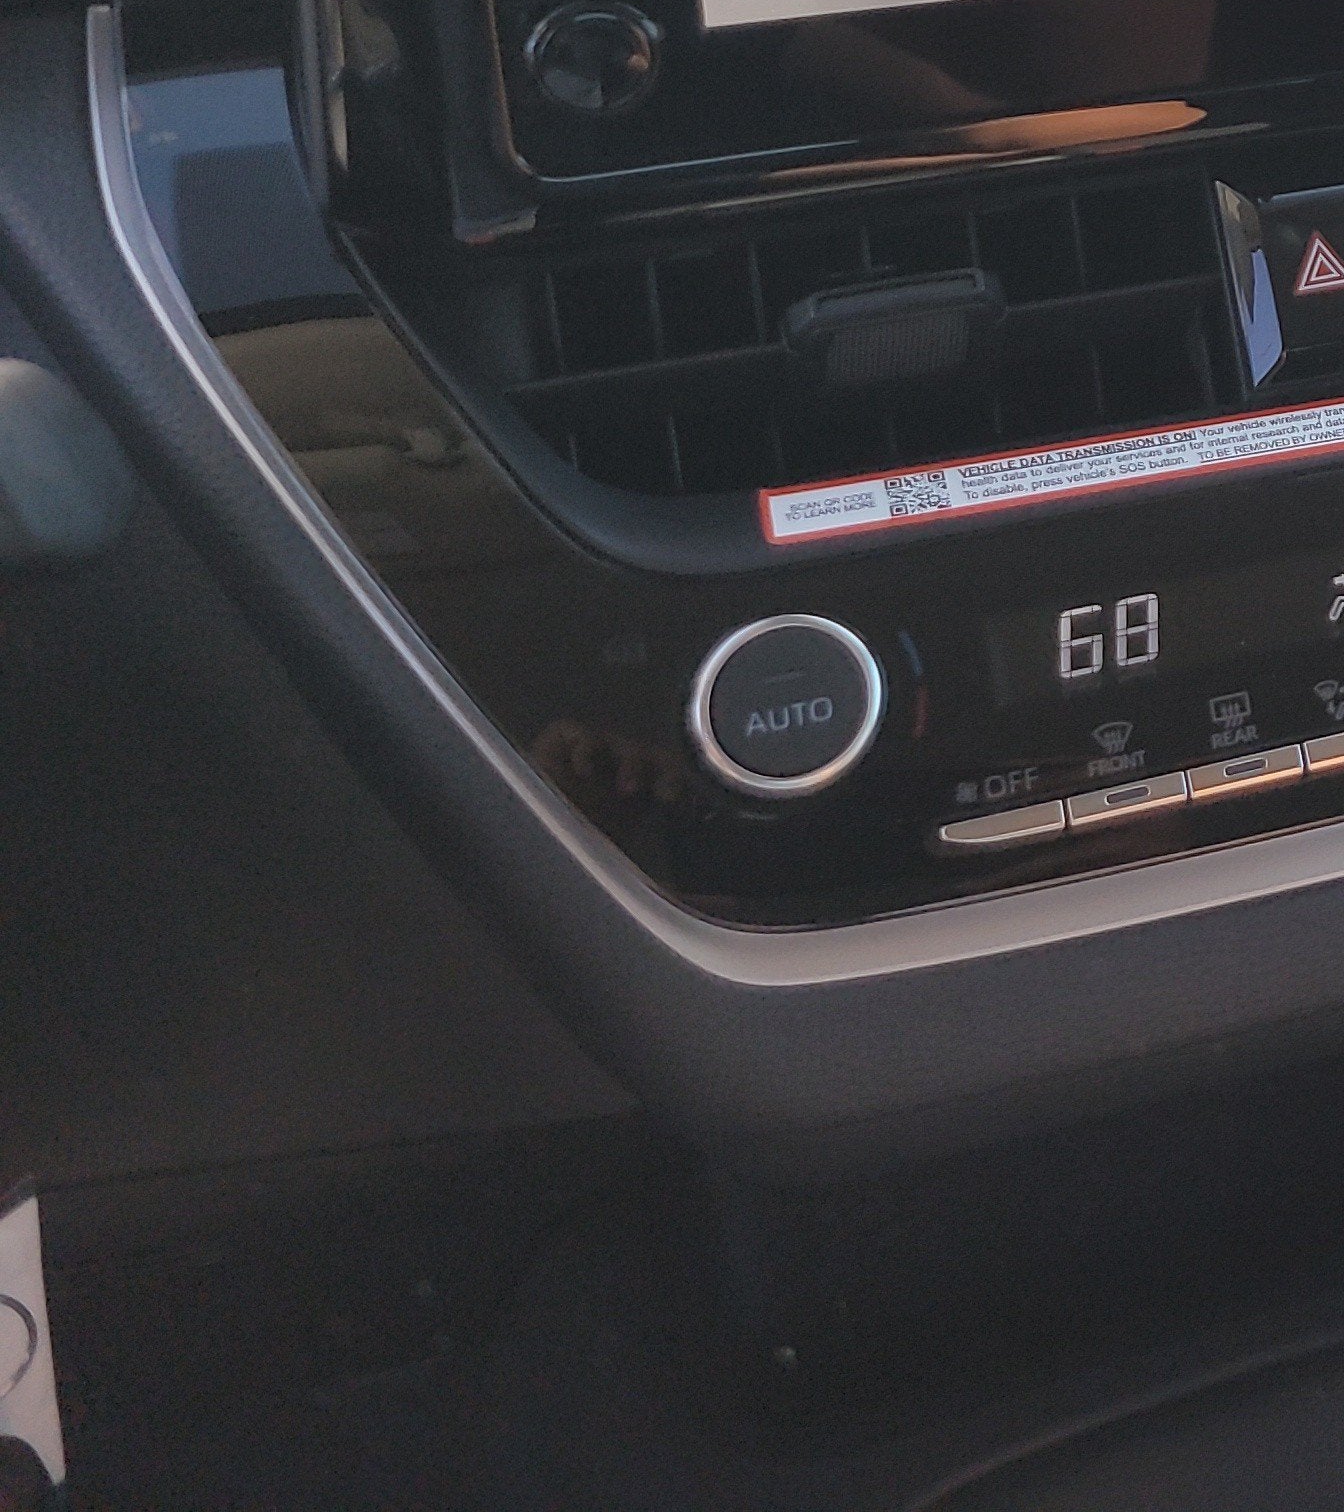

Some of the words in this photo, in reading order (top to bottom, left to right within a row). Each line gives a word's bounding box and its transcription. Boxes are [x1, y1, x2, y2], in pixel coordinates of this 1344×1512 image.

[958, 461, 1015, 476] VEHICLE
[1020, 455, 1053, 467] DATA
[1055, 440, 1154, 461] TRANSMISSION
[1157, 435, 1168, 445] IS
[1200, 427, 1223, 437] Your
[1227, 421, 1266, 432] vehicle
[1269, 411, 1321, 428] wirelessly
[961, 476, 998, 488] health
[1001, 472, 1027, 481] data
[1046, 462, 1082, 474] deliver
[1087, 457, 1112, 468] your
[1116, 450, 1162, 462] services
[1166, 444, 1186, 454] and
[1190, 442, 1203, 450] for
[1252, 426, 1299, 440] research
[1303, 422, 1322, 431] and
[963, 491, 978, 500] To
[1031, 478, 1063, 489] press
[1119, 462, 1146, 474] SOS
[1149, 457, 1188, 468] button.
[1197, 451, 1213, 460] TO
[1216, 448, 1230, 457] BE
[1234, 438, 1290, 454] REMOVED
[1292, 435, 1306, 444] BY
[1057, 592, 1161, 680] 68
[745, 695, 834, 738] AUTO
[1211, 724, 1260, 750] REAR
[983, 767, 1040, 800] OFF
[1087, 747, 1146, 779] FRONT
